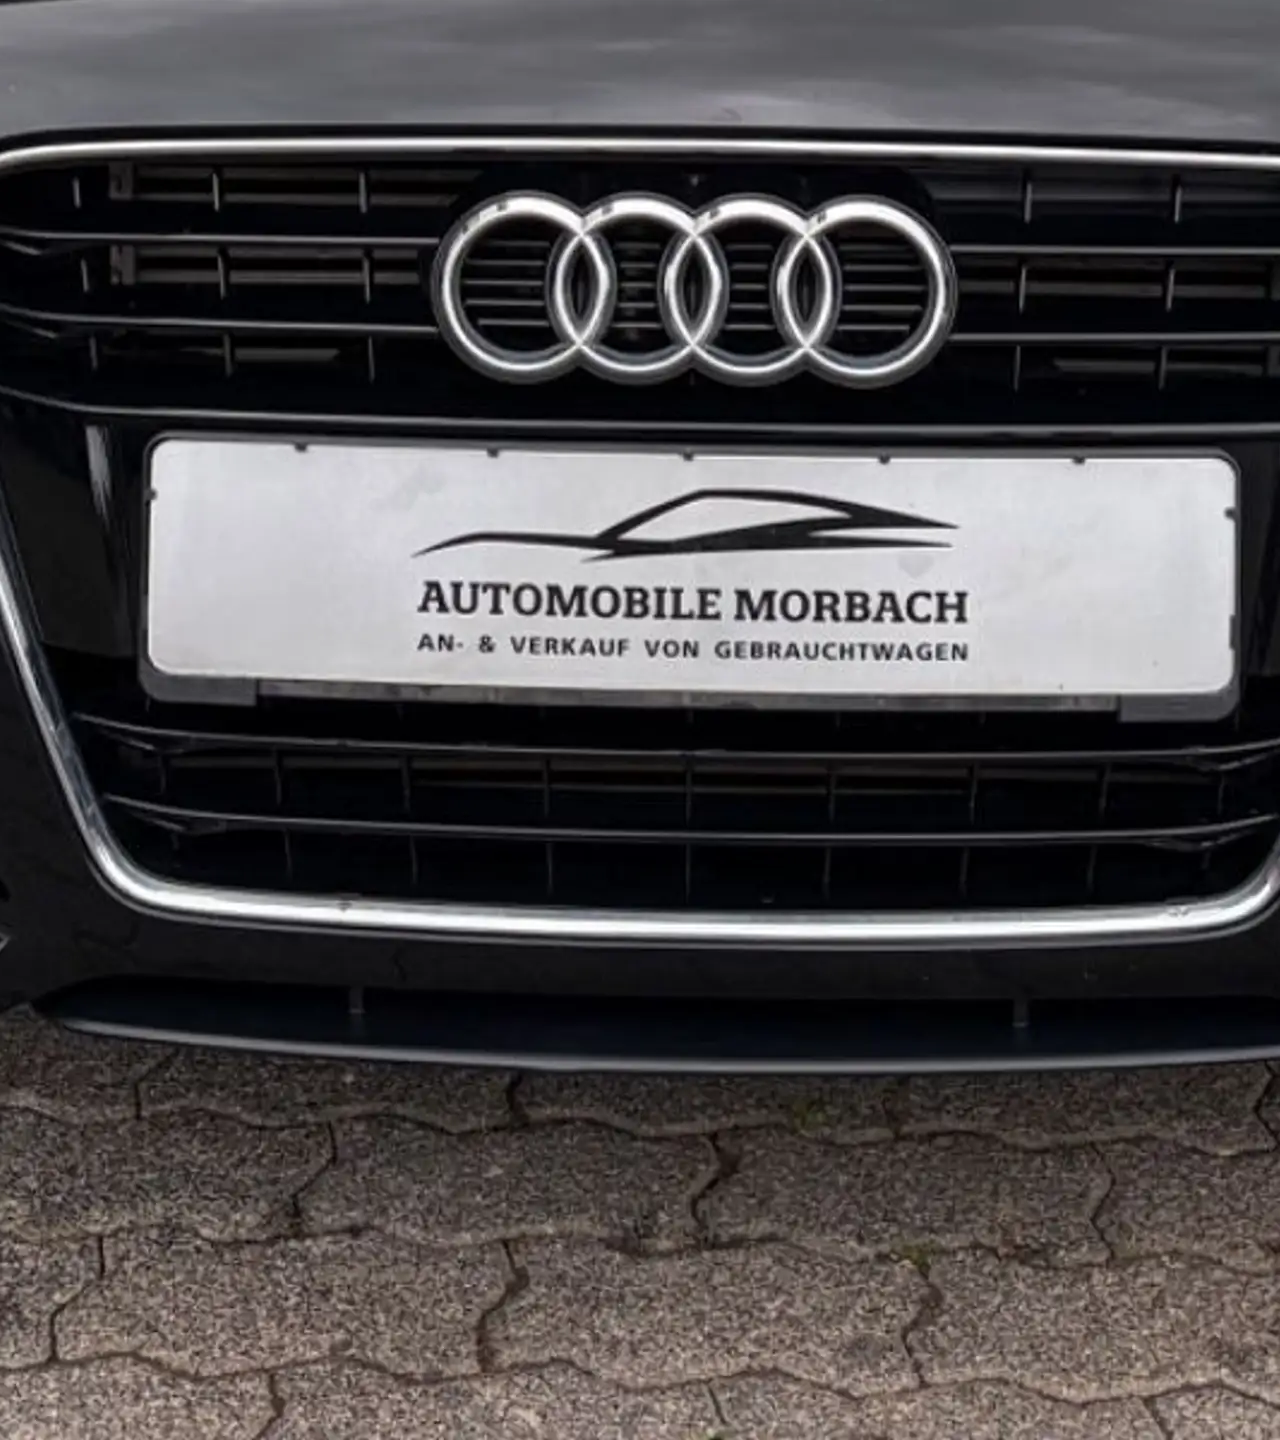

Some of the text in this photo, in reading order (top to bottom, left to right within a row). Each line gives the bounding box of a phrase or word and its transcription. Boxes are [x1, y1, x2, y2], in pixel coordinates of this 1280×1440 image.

[417, 580, 969, 625] AUTOMOBILE MORBACH
[417, 633, 969, 663] AN- & VERKAUF VON GEBRAUCHTWAGEN
